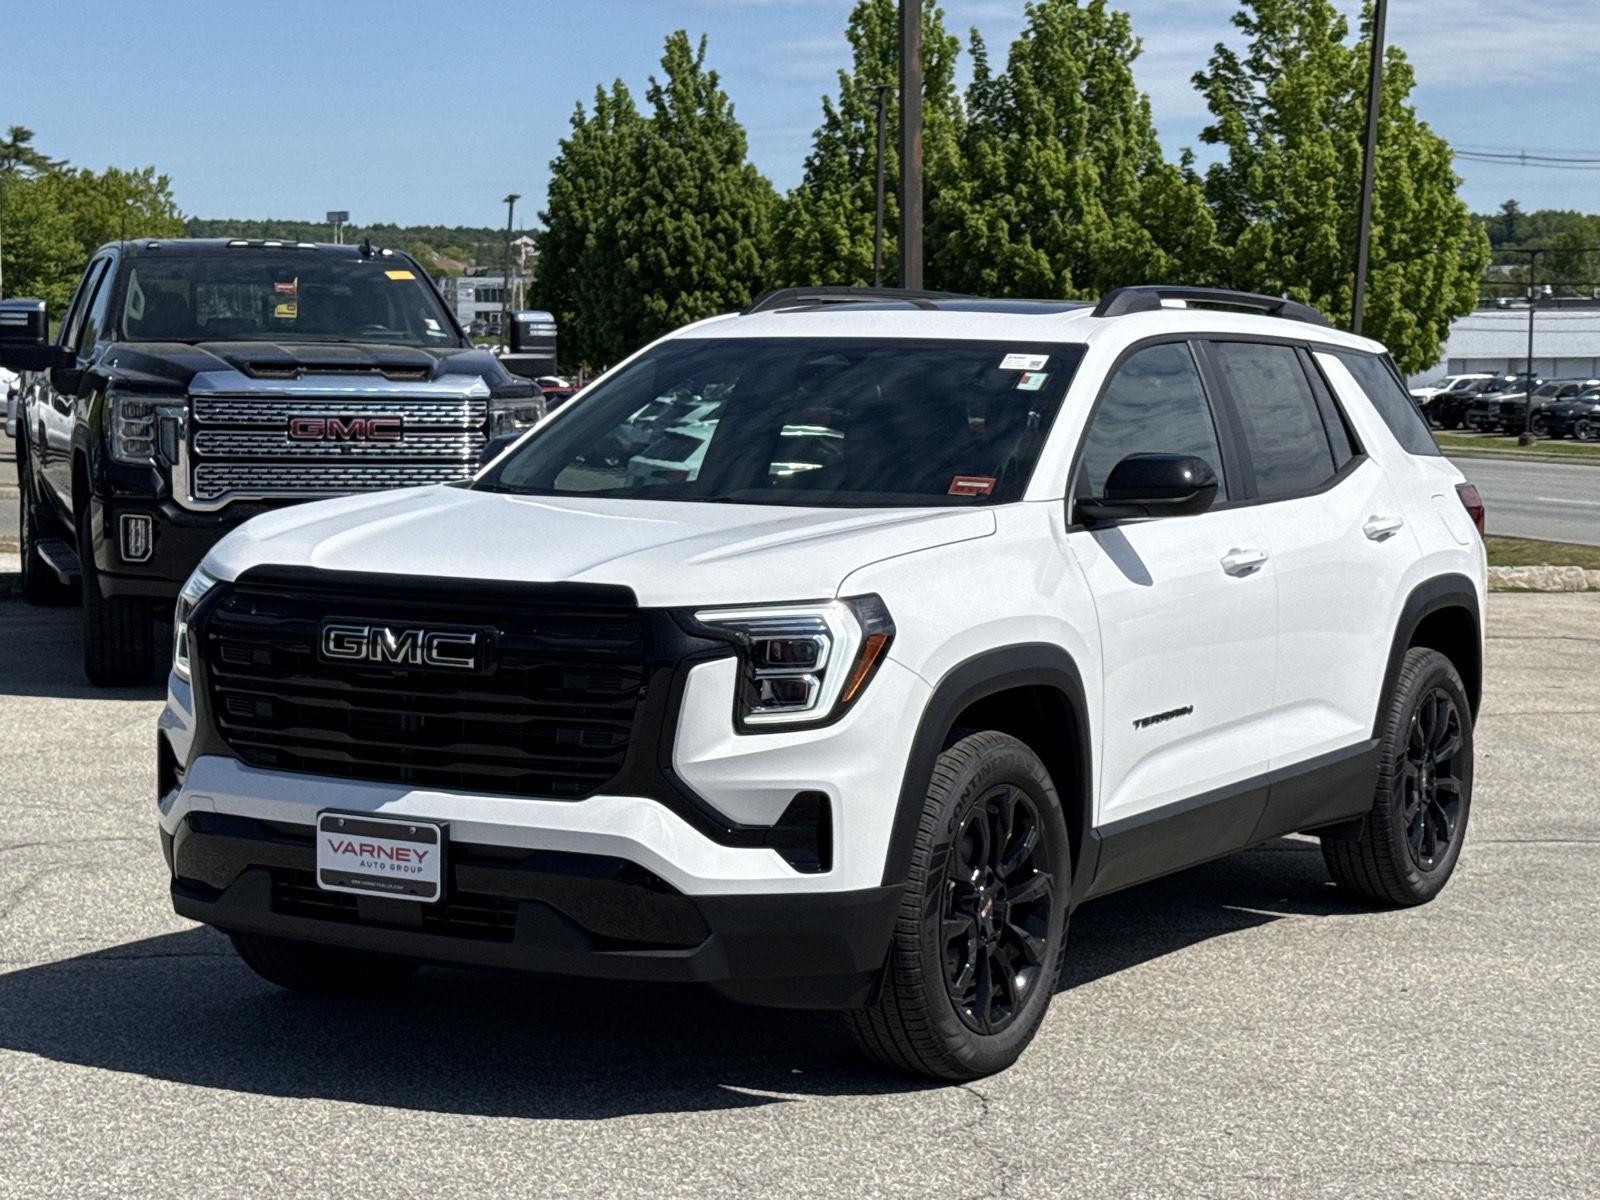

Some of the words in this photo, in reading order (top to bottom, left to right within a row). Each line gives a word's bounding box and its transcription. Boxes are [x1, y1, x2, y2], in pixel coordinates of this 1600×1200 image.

[289, 417, 401, 440] GMC
[322, 623, 477, 669] GMC
[327, 838, 430, 864] VARNEY
[359, 860, 386, 870] AUTO
[390, 863, 424, 874] GROUP
